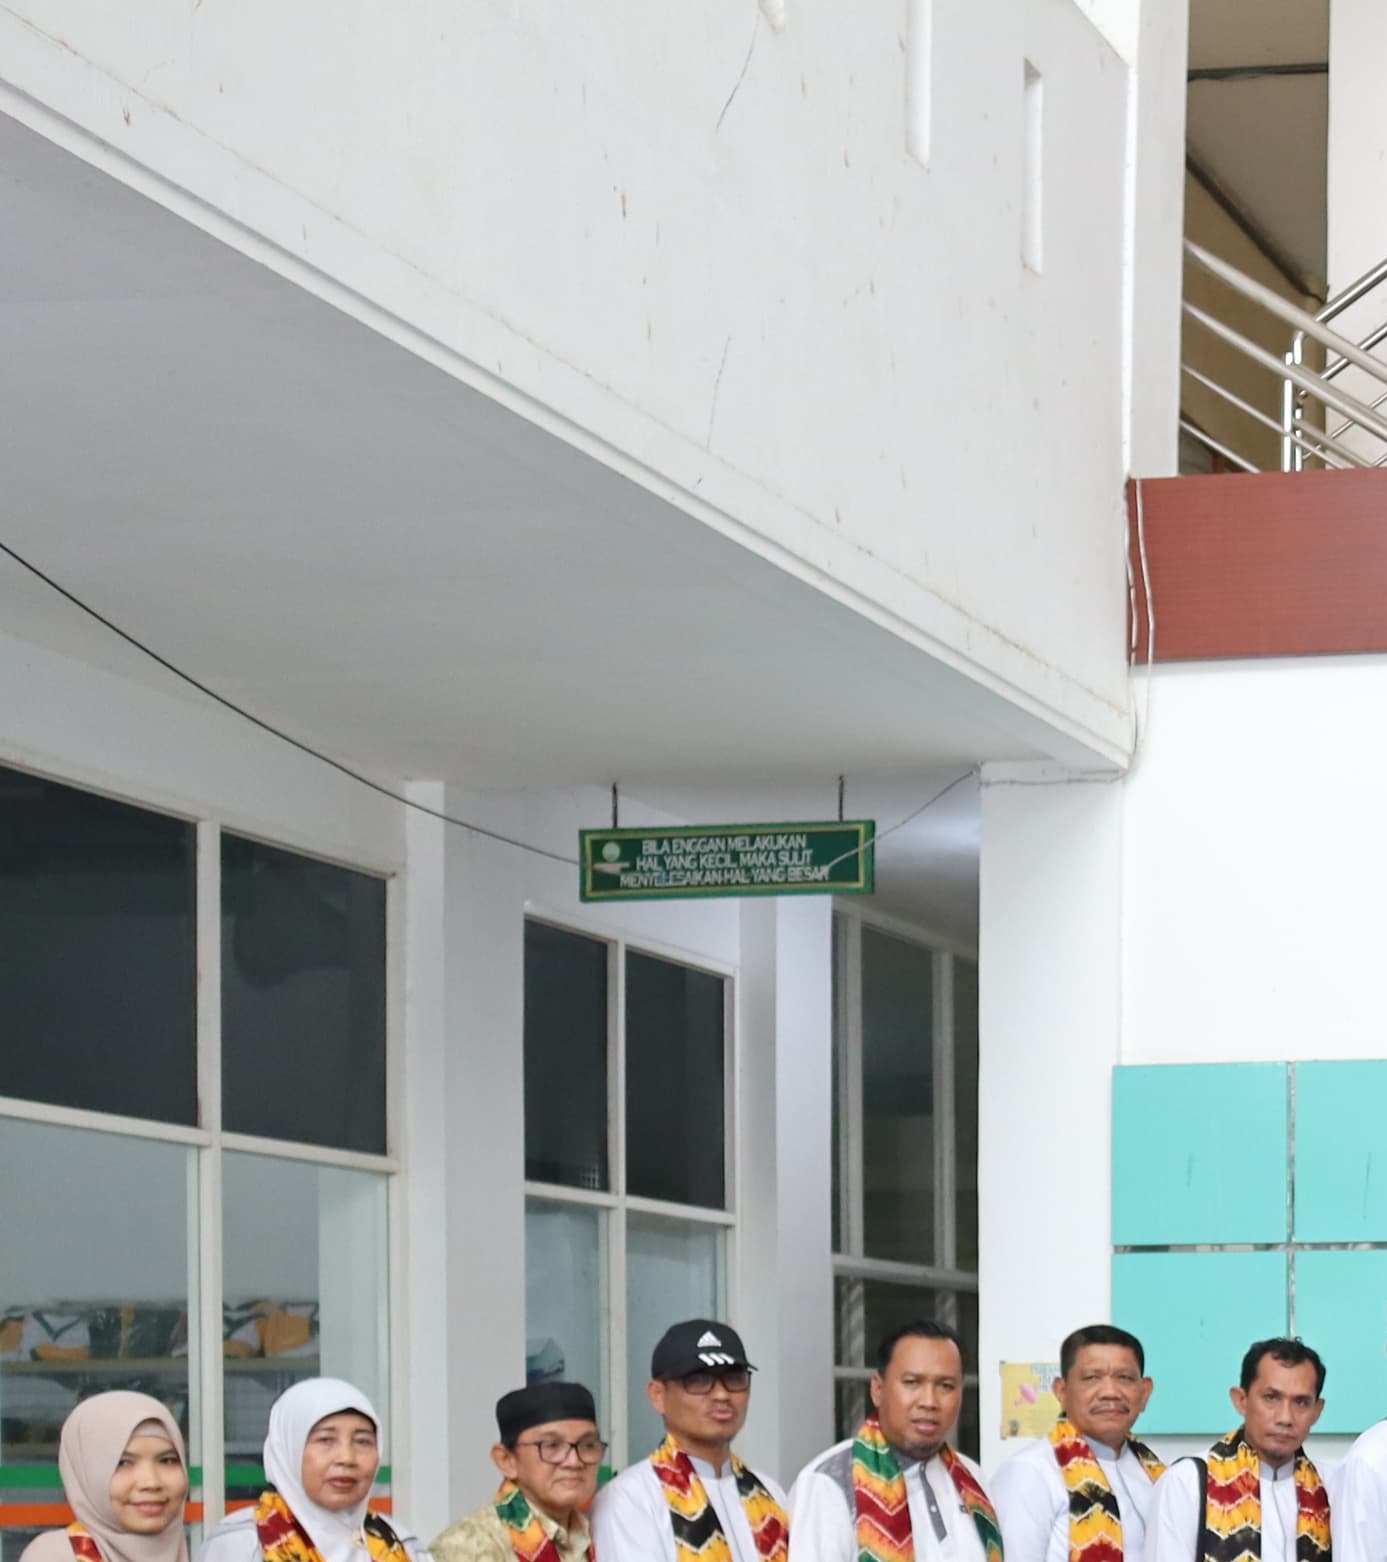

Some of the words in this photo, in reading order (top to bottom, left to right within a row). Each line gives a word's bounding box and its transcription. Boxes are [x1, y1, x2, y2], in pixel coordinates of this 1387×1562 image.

[642, 839, 671, 856] BILA
[672, 837, 727, 855] ENGGAN
[727, 834, 807, 852] MELAKUKAN
[636, 856, 662, 871] HAL
[664, 855, 698, 870] YANG
[739, 851, 777, 867] MAKA
[778, 849, 813, 865] SULIT
[750, 866, 786, 882] YANG
